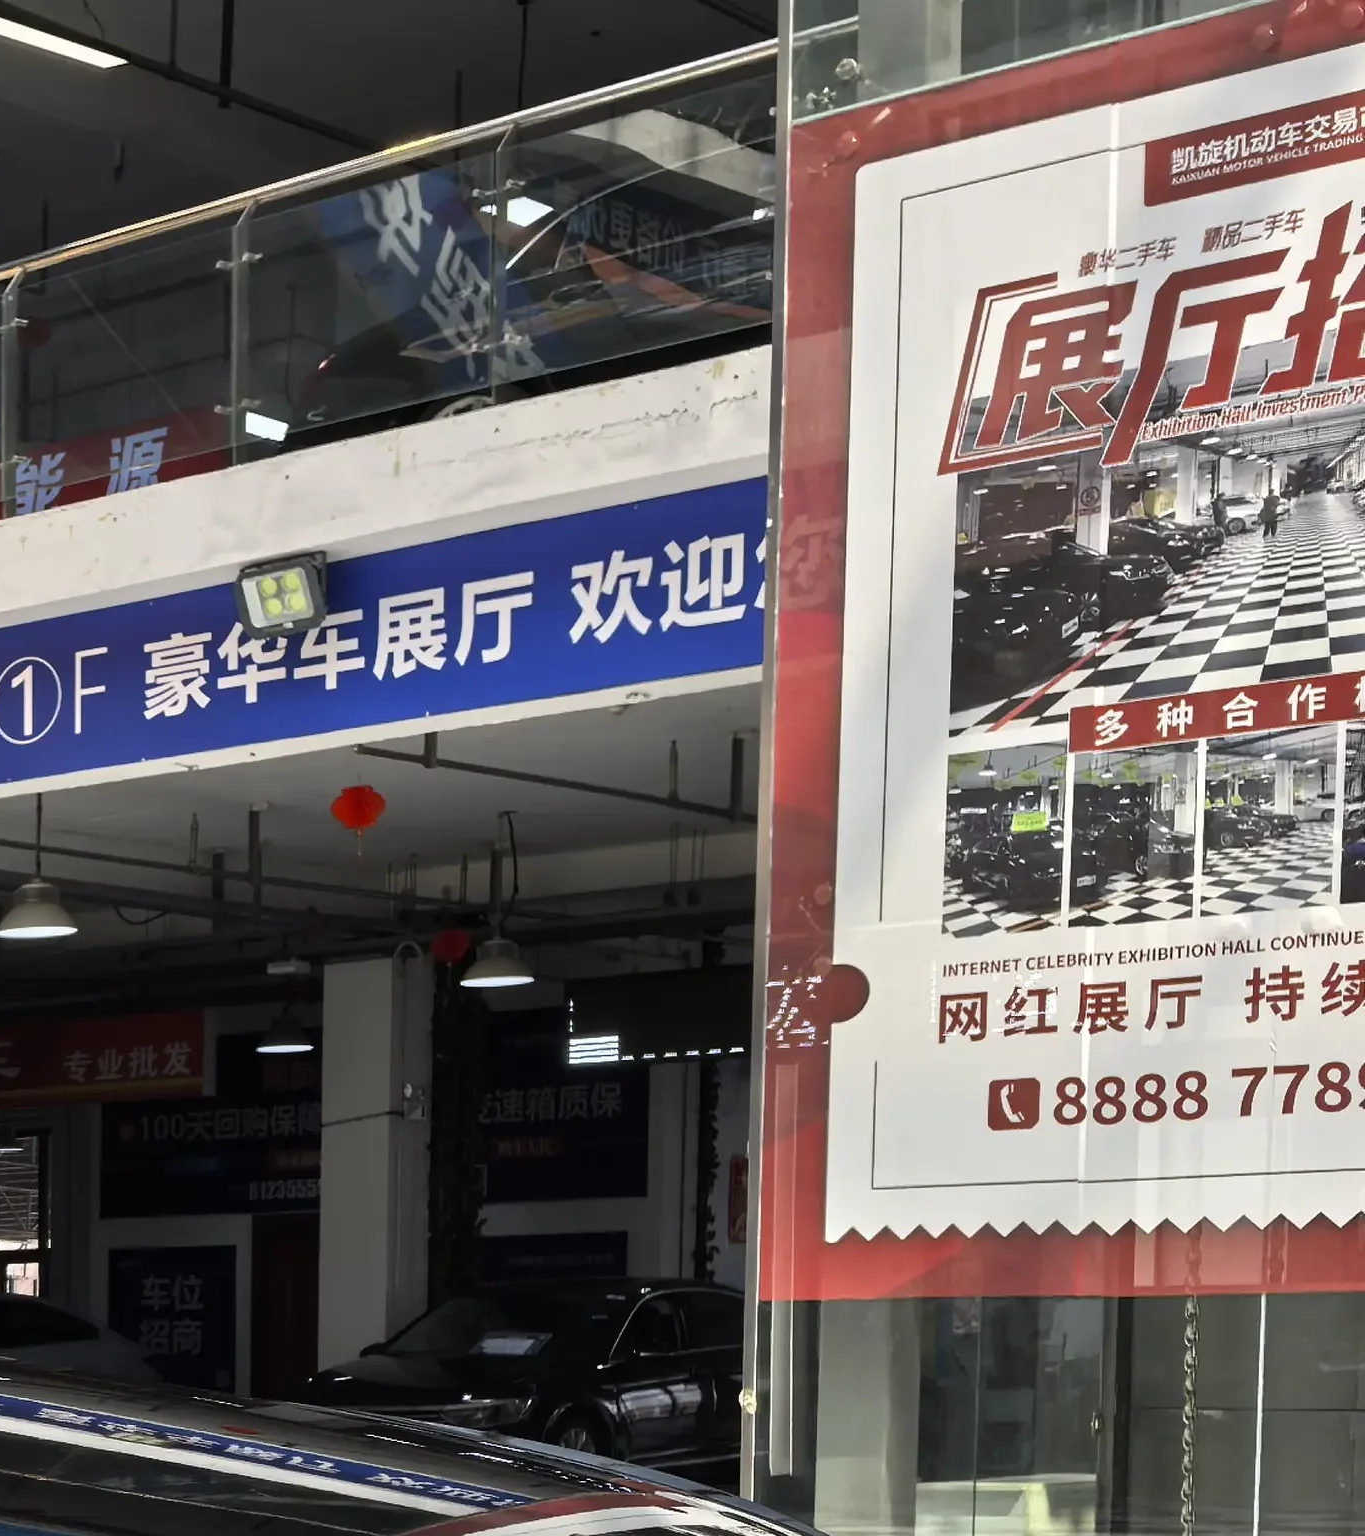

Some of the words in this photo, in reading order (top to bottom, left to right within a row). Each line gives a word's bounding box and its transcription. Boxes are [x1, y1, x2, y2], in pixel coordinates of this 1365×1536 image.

[1170, 106, 1365, 173] 凯旋机动车交易
[1223, 158, 1263, 174] MOTOR
[1267, 148, 1310, 164] VEHICLE
[1221, 405, 1252, 427] Hall
[1257, 388, 1349, 420] Investment
[142, 572, 535, 723] 豪华车展厅
[1094, 681, 1365, 746] 多种合作
[943, 958, 1022, 978] INTERNET
[1026, 951, 1115, 972] CELEBRITY
[1118, 943, 1216, 966] EXHIBITION
[1222, 937, 1266, 956] HALL
[938, 975, 1203, 1044] 网红展厅
[63, 1040, 194, 1084] 专业批发
[1053, 1070, 1209, 1127] 8888
[140, 1273, 205, 1312] 车位
[139, 1317, 205, 1356] 招商
